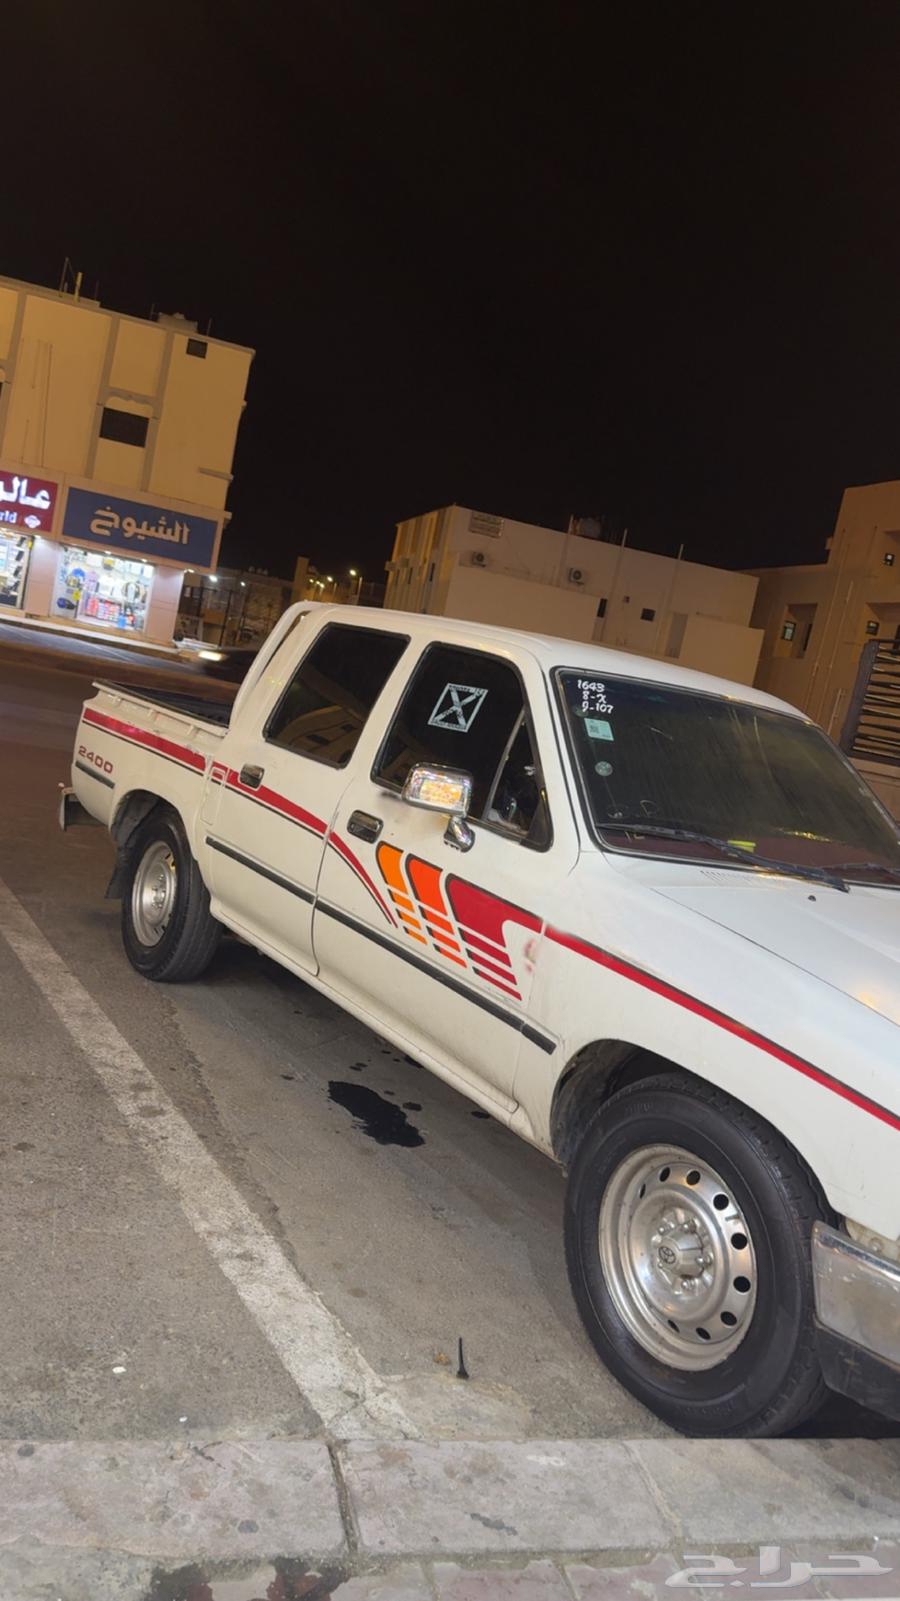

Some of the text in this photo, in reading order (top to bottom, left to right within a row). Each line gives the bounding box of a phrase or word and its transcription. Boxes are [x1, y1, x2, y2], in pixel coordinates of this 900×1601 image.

[90, 506, 191, 545] الشيوخ
[577, 679, 605, 693] 1643
[78, 745, 113, 774] 2400
